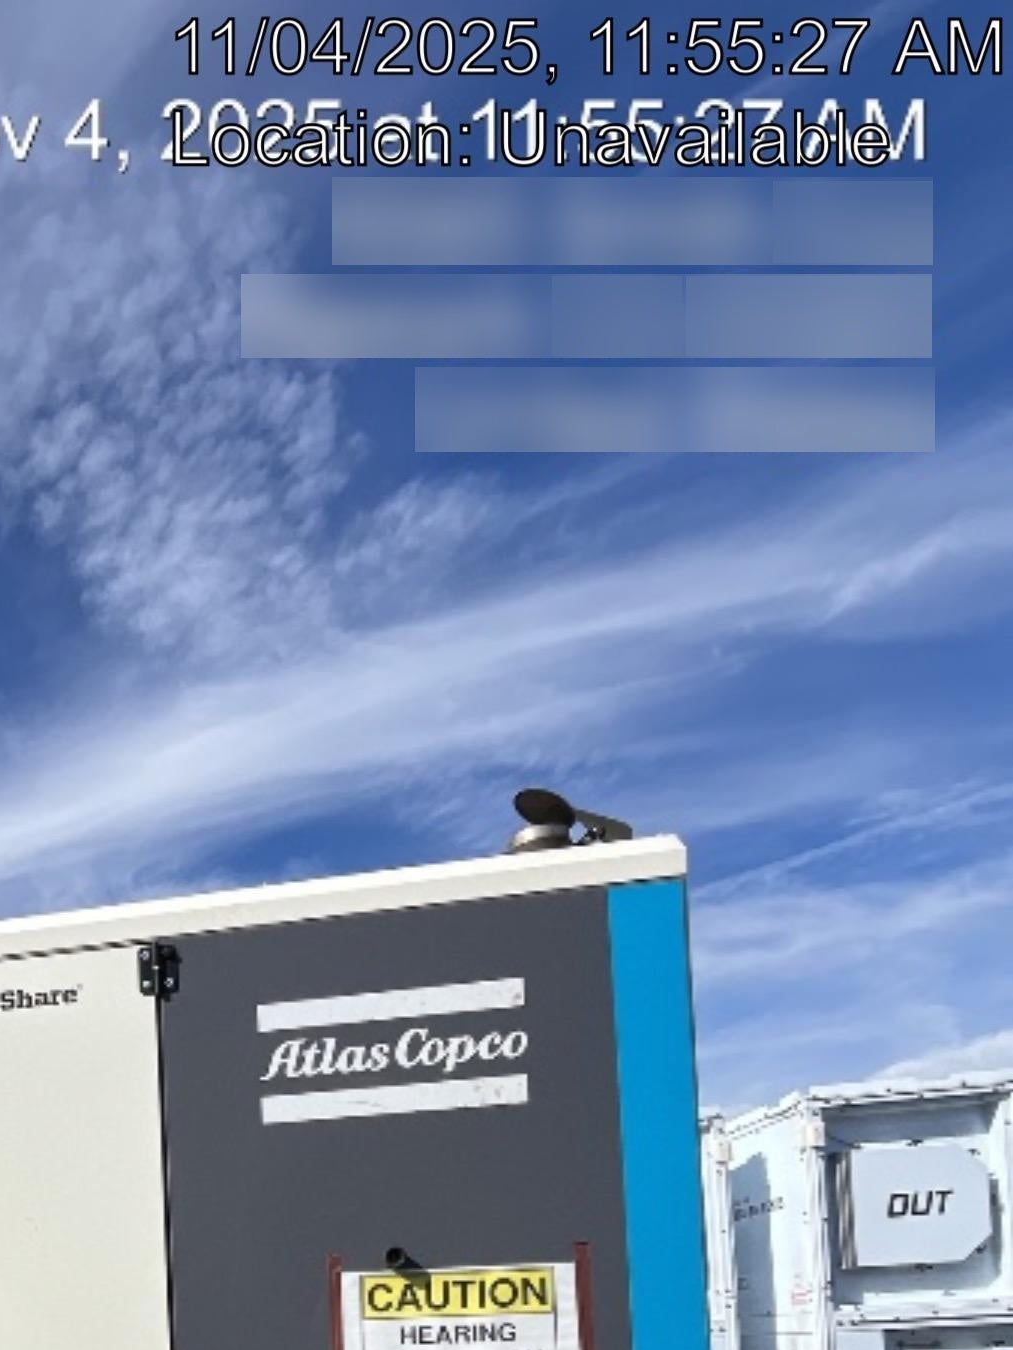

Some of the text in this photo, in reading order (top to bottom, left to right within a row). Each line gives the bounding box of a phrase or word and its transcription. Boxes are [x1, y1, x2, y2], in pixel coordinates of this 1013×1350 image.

[259, 1028, 529, 1082] Atlas Copco
[887, 1190, 954, 1219] OUT
[367, 1277, 549, 1313] CAUTION
[399, 1322, 517, 1346] HEARING
